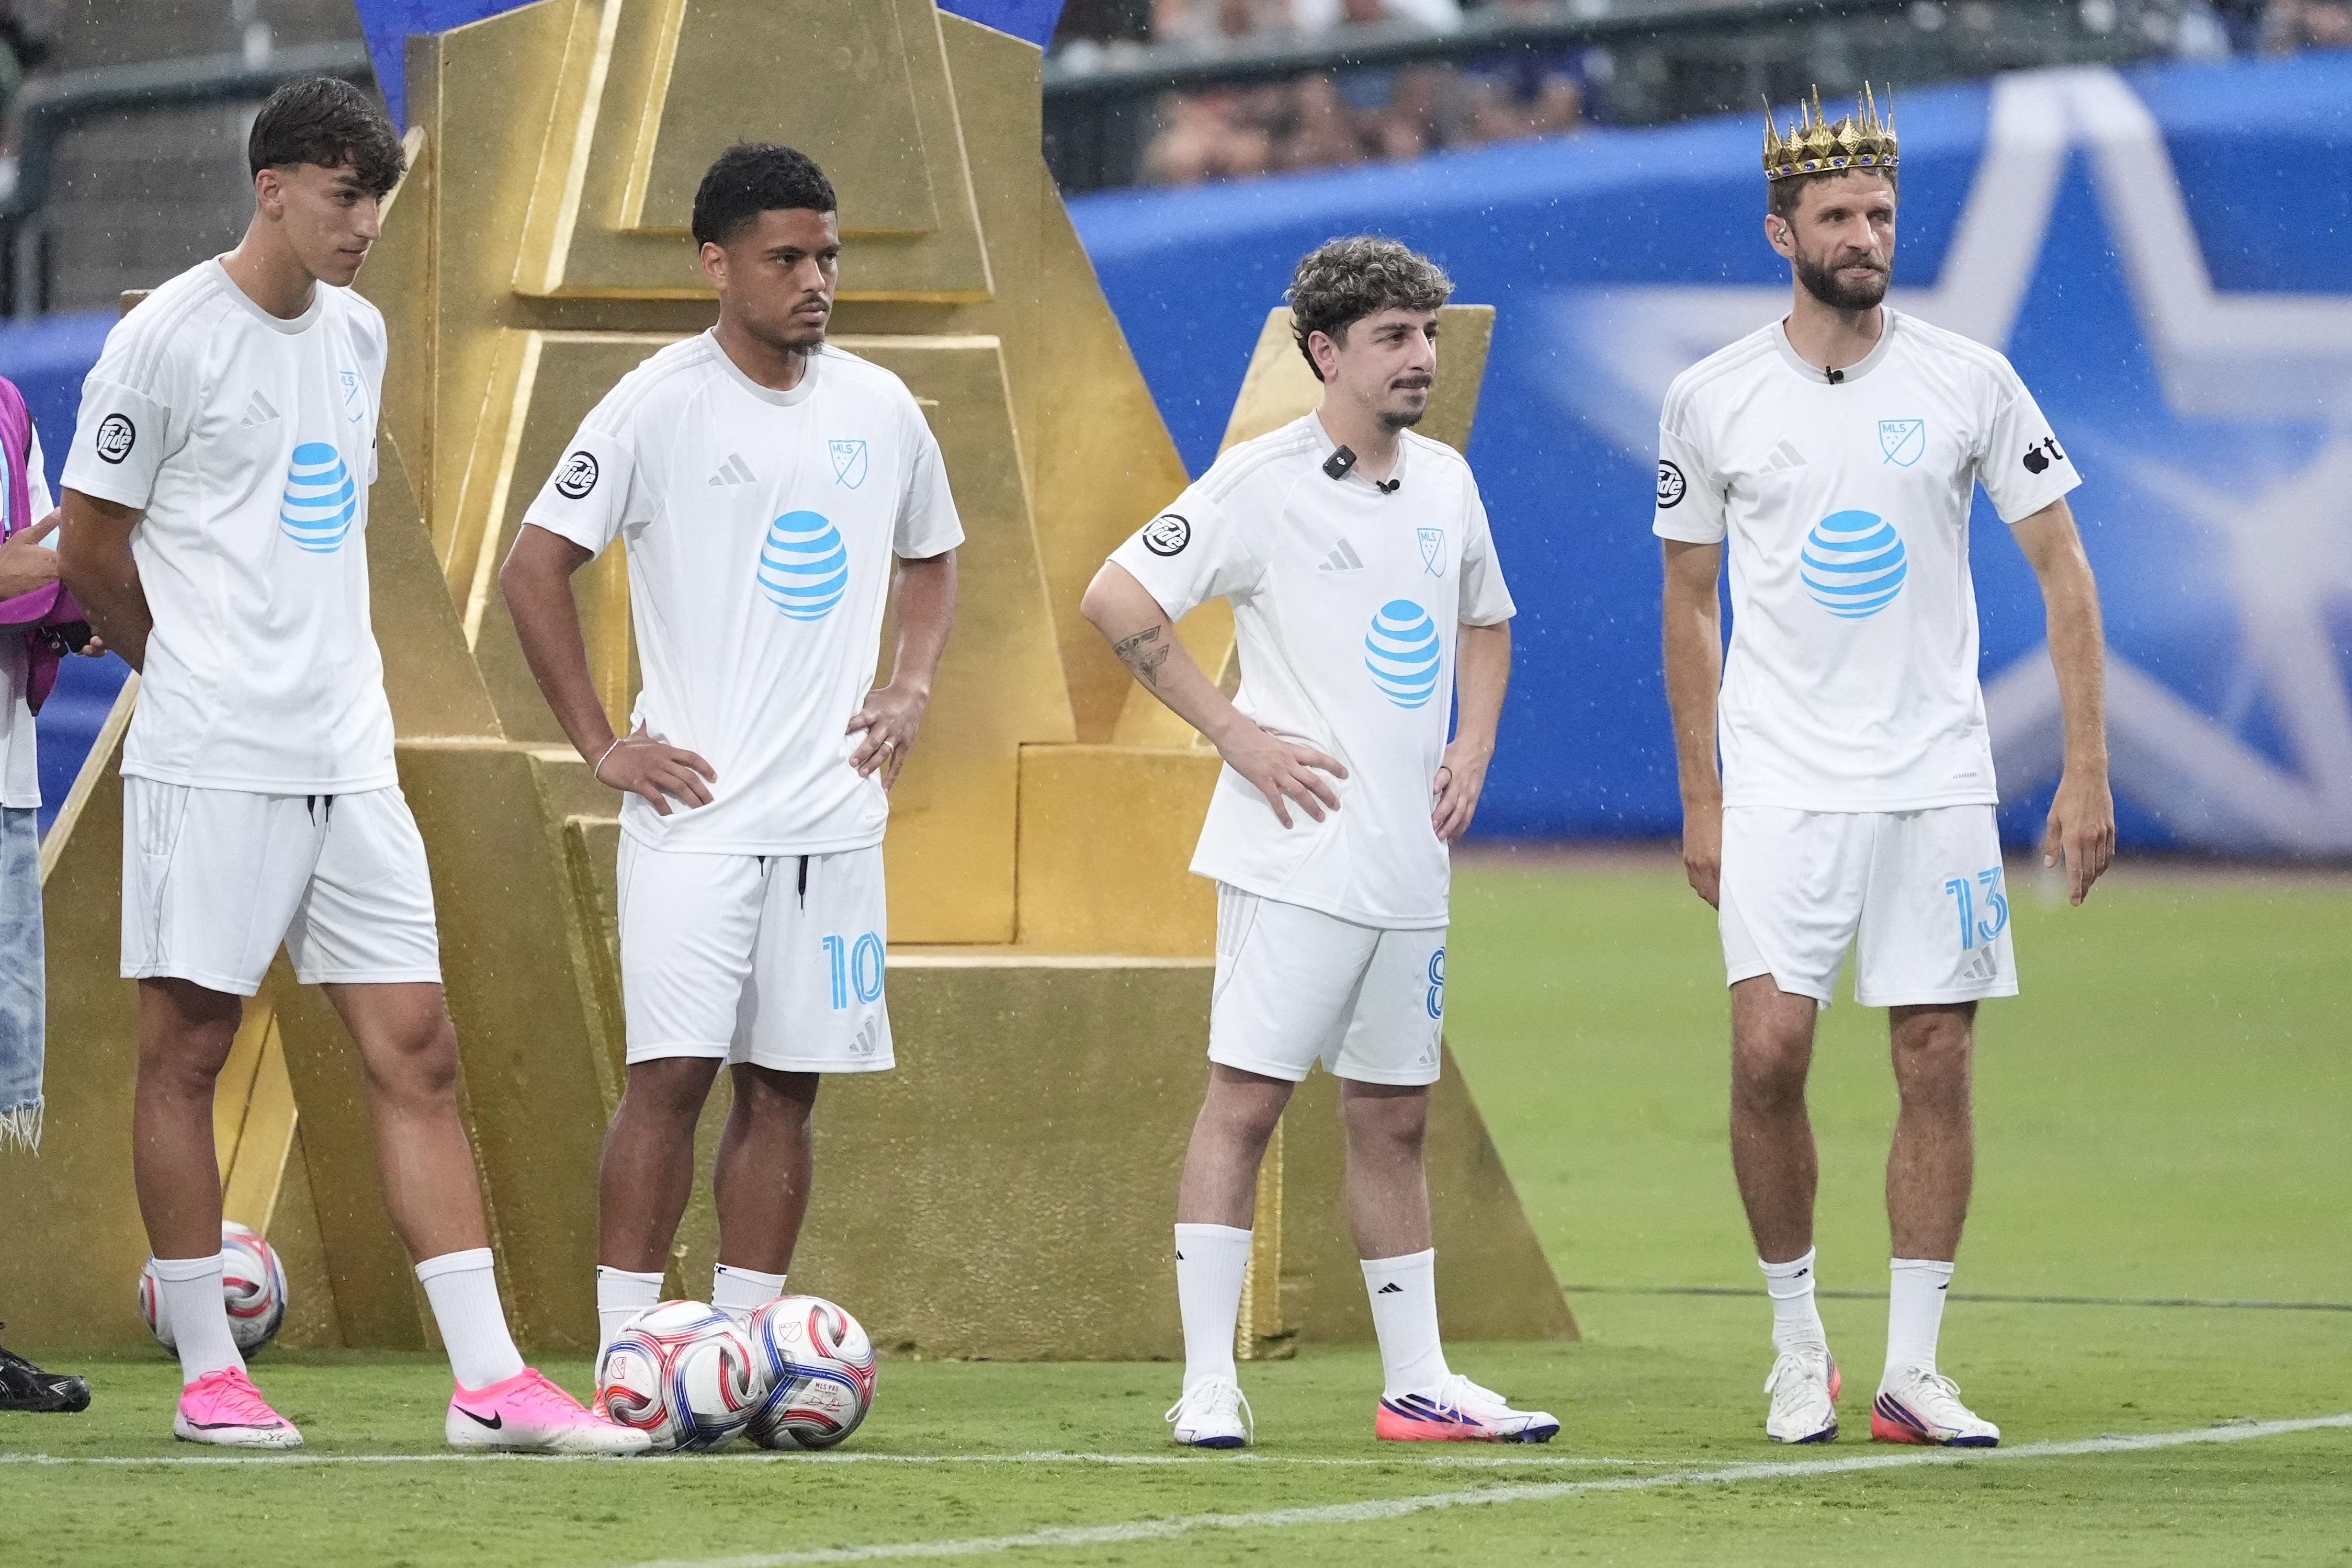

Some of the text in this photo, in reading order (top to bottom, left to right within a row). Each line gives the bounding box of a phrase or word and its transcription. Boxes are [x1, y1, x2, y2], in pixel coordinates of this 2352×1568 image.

[342, 376, 354, 386] LS
[97, 424, 132, 451] Tide
[1883, 424, 1906, 433] MLS
[832, 444, 853, 453] MLS
[555, 461, 596, 487] Tide
[1657, 470, 1683, 495] ide
[1143, 517, 1184, 549] Tide
[1420, 531, 1437, 541] MLS
[1946, 866, 2008, 950] 13
[822, 930, 885, 1010] 10
[1427, 946, 1445, 1019] 8
